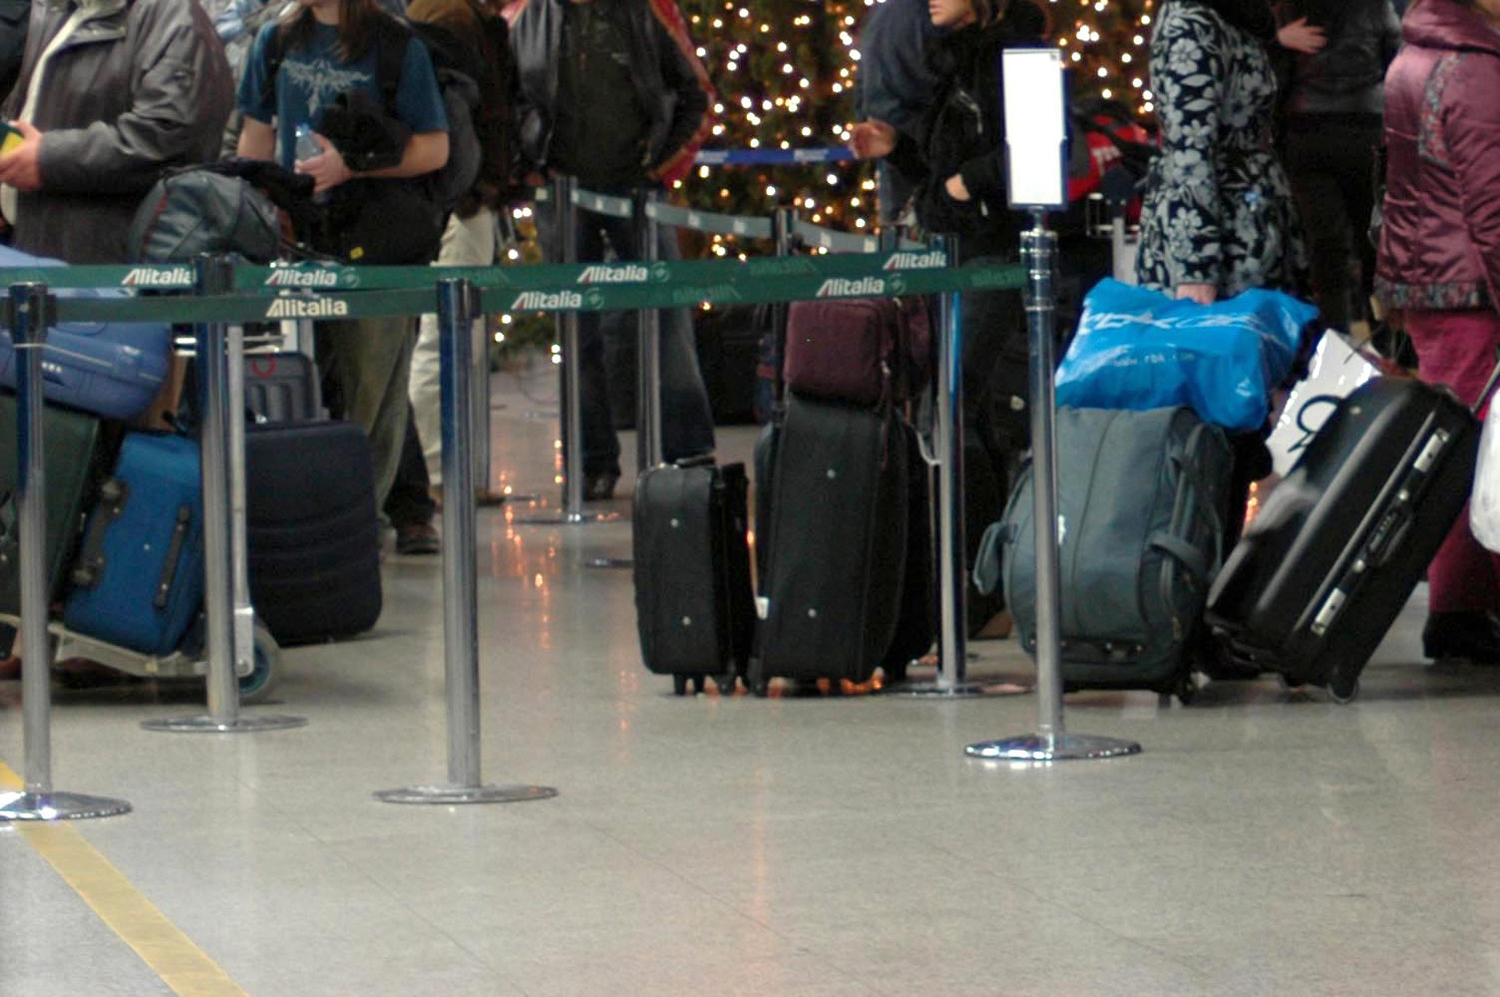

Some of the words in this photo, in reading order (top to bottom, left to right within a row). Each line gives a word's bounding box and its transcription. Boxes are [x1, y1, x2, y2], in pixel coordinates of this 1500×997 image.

[265, 269, 337, 287] Alitalia
[577, 265, 648, 283] Alitalia
[816, 277, 884, 297] Alitalia
[265, 298, 347, 317] Alitalia
[511, 291, 582, 310] Alitalia
